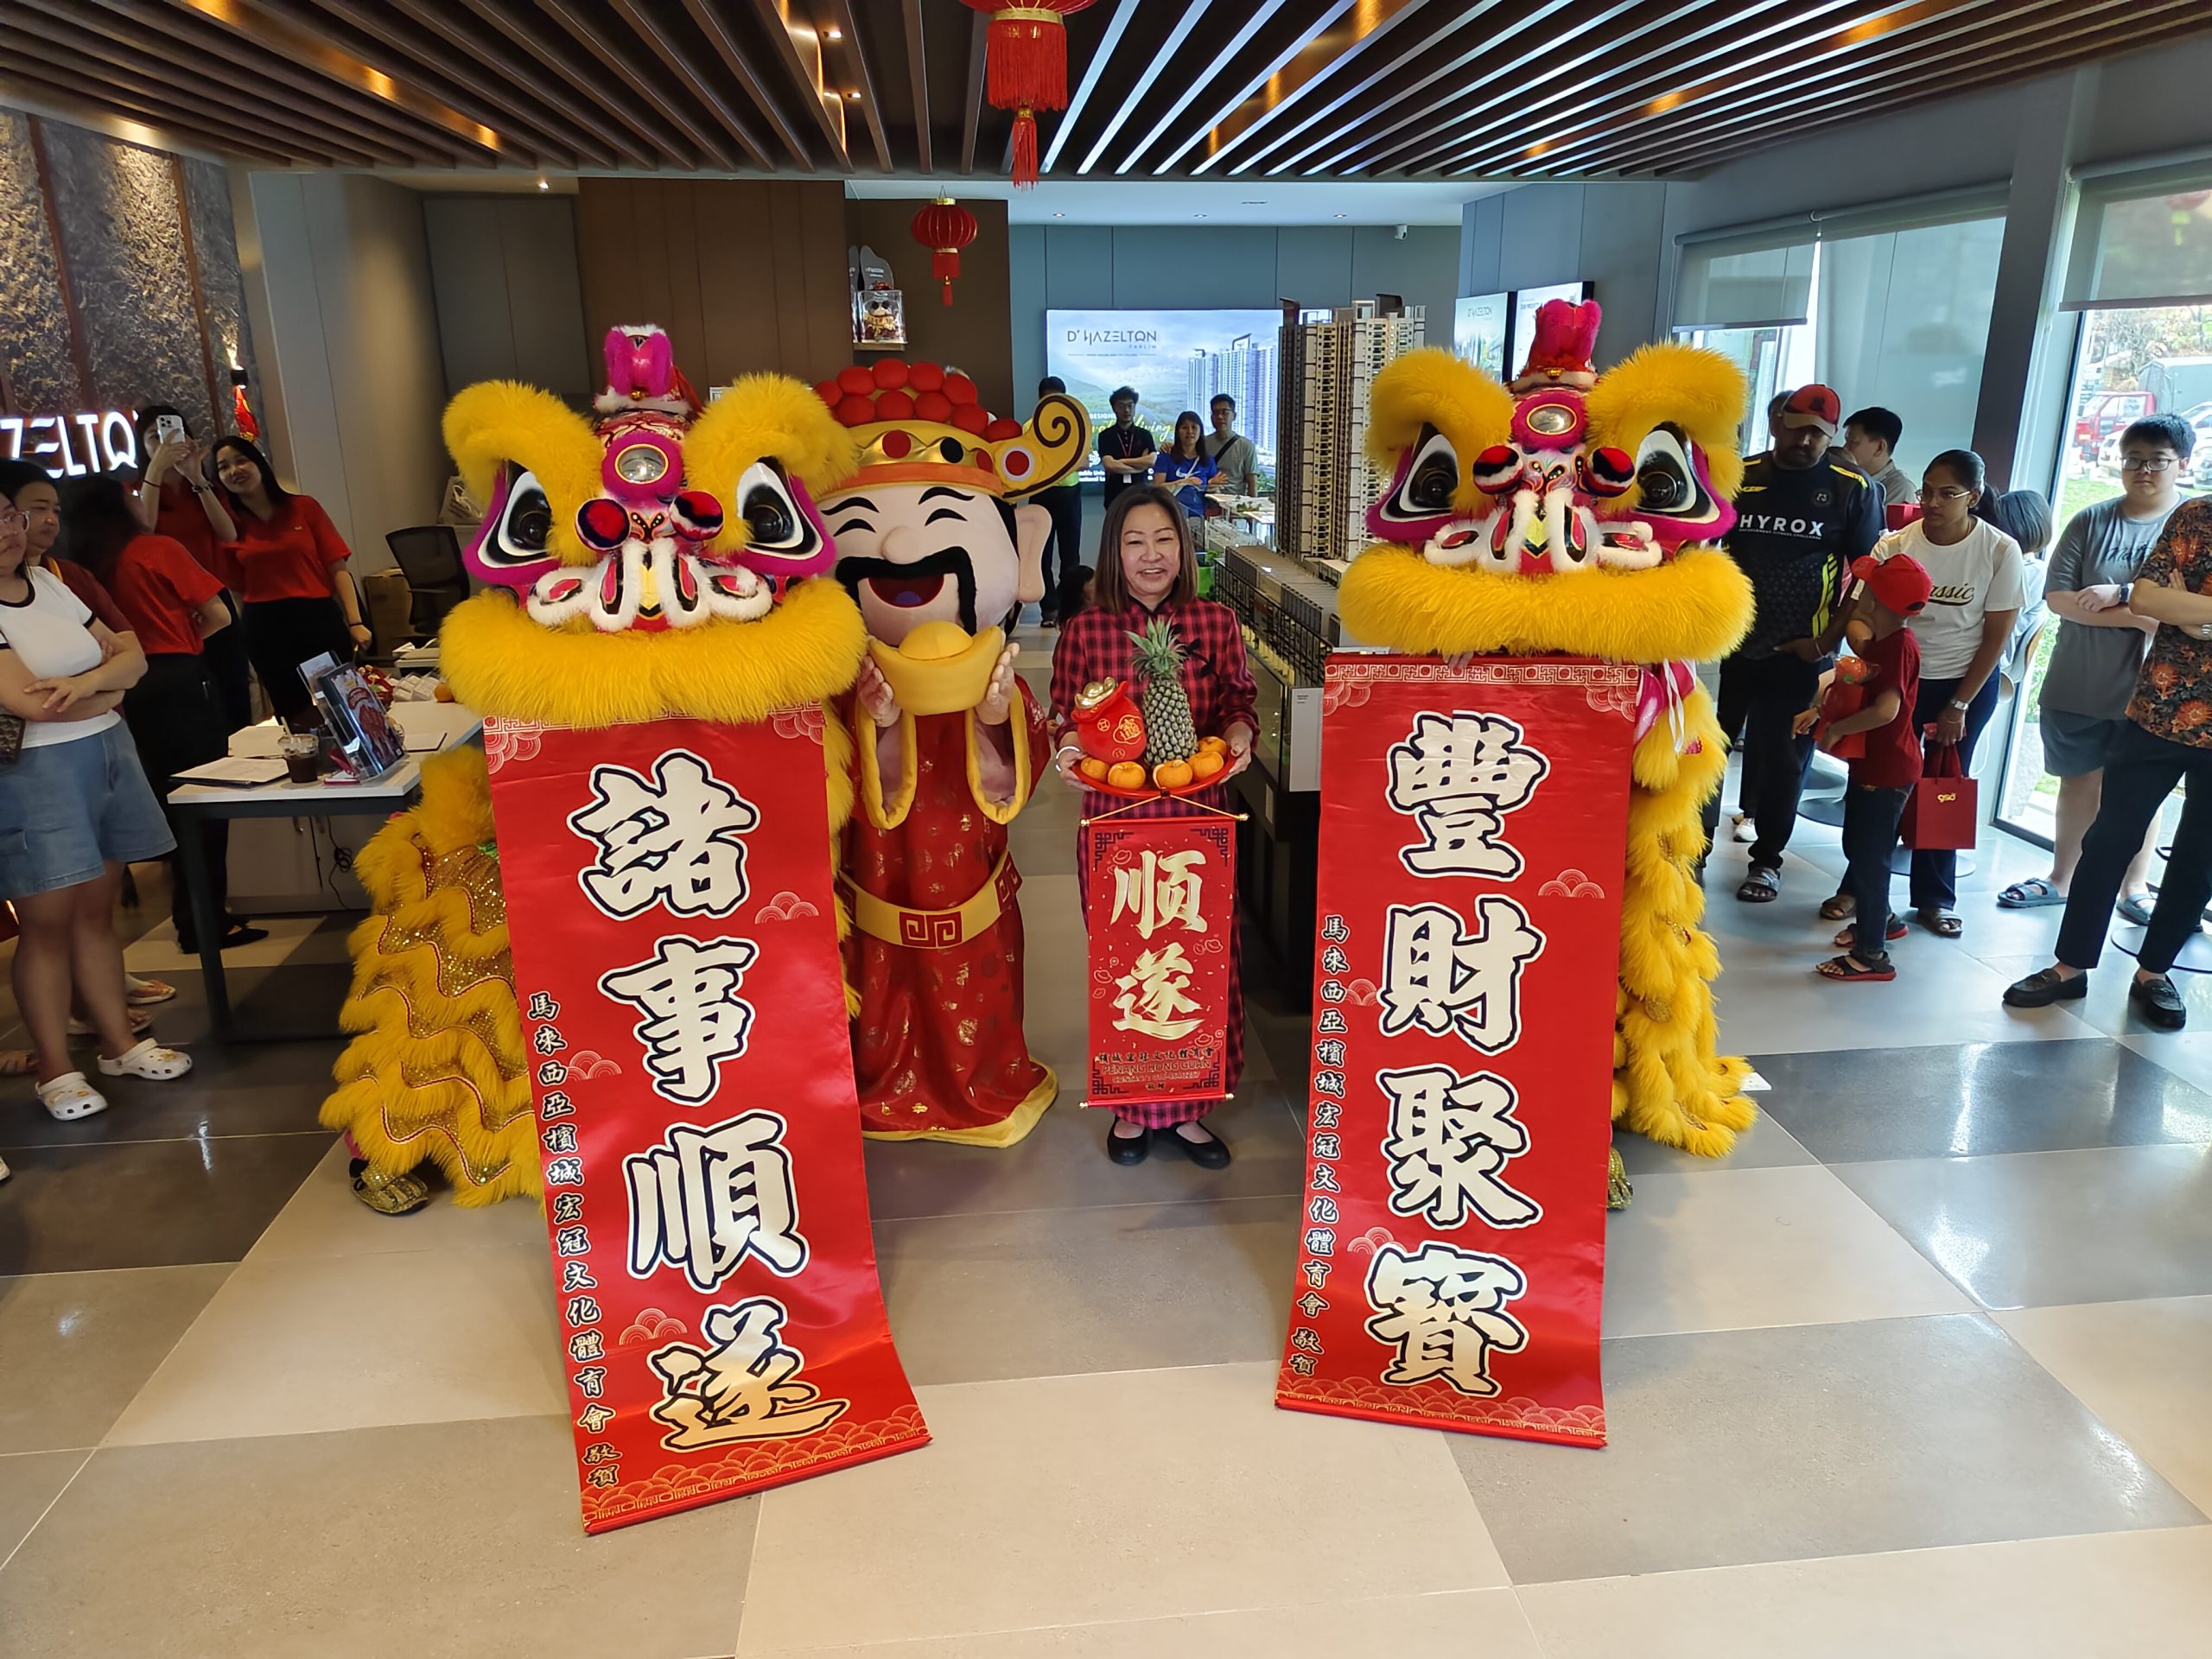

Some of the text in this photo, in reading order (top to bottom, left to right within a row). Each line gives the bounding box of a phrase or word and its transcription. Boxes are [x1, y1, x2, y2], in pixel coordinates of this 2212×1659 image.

[1739, 514, 1825, 537] HYROX
[1930, 582, 1975, 600] assic
[1110, 849, 1208, 1040] 順遂
[1103, 1059, 1211, 1075] PENANG HONG GUAN
[567, 748, 850, 1452] 諸事順遂
